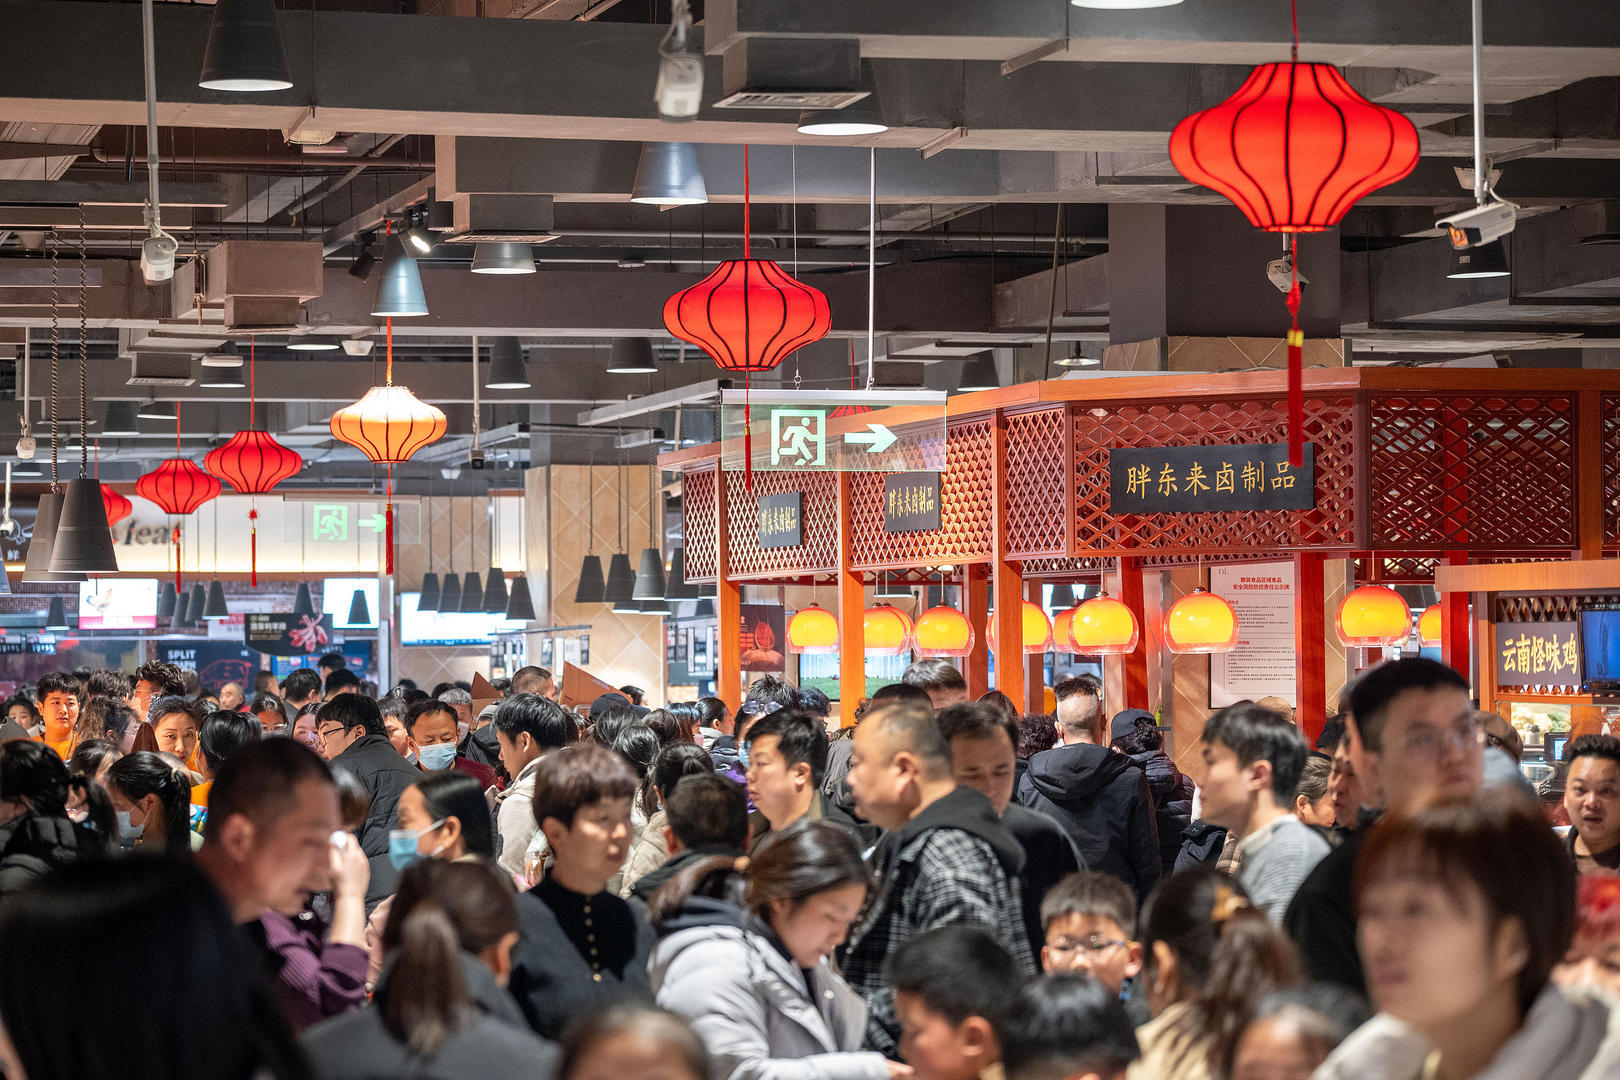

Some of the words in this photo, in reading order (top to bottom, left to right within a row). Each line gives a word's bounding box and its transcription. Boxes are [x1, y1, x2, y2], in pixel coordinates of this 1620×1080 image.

[1126, 460, 1296, 499] 胖东来卤制品
[167, 649, 197, 660] SPLIT
[1502, 632, 1578, 675] 云南怪味鸡
